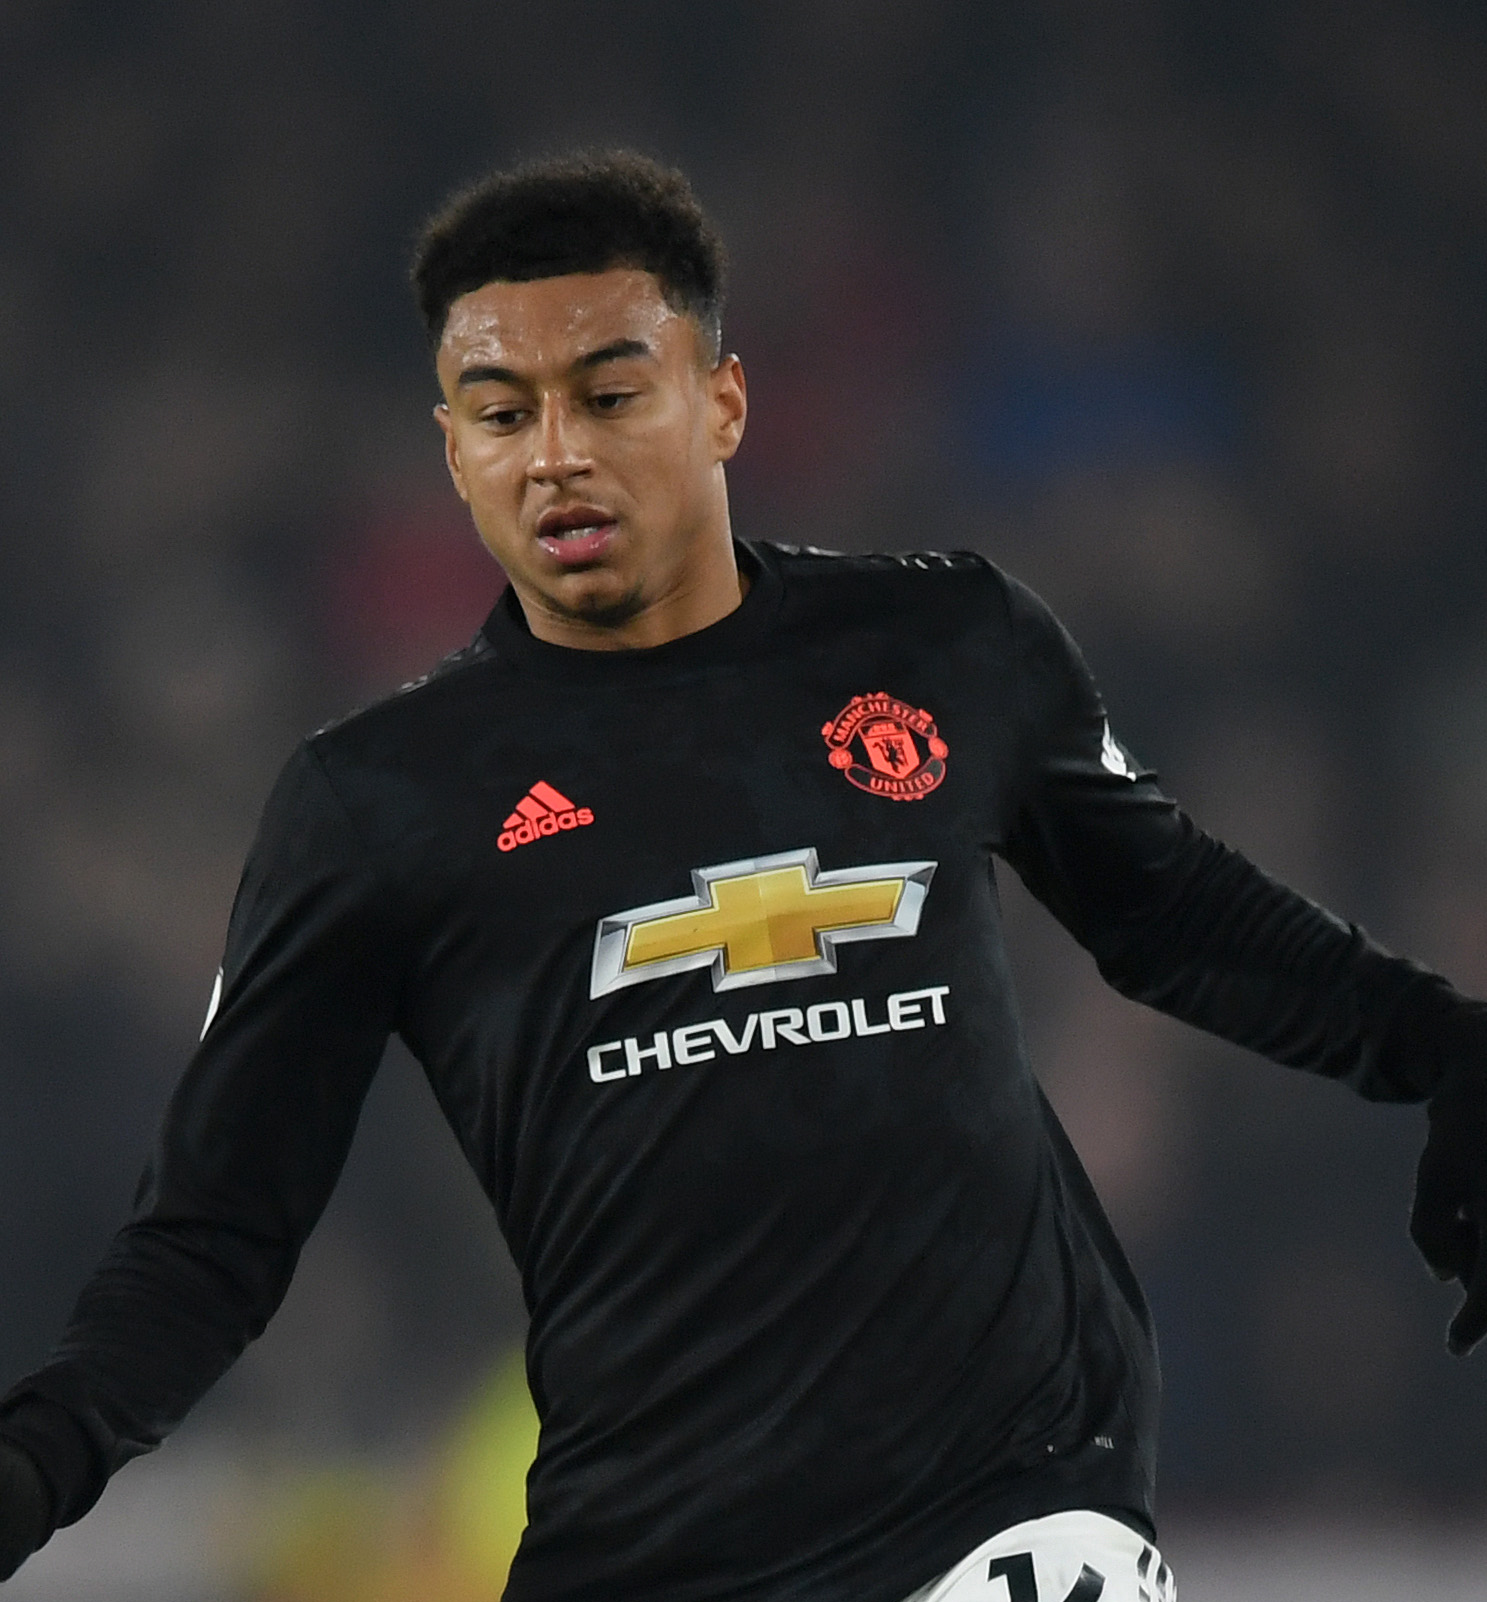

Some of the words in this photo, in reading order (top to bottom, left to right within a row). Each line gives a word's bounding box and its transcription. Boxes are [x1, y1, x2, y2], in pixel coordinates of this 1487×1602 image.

[833, 701, 928, 742] MANCHESTER
[870, 772, 934, 793] UNITED
[496, 806, 594, 852] adidas
[587, 986, 949, 1083] CHEVROLET
